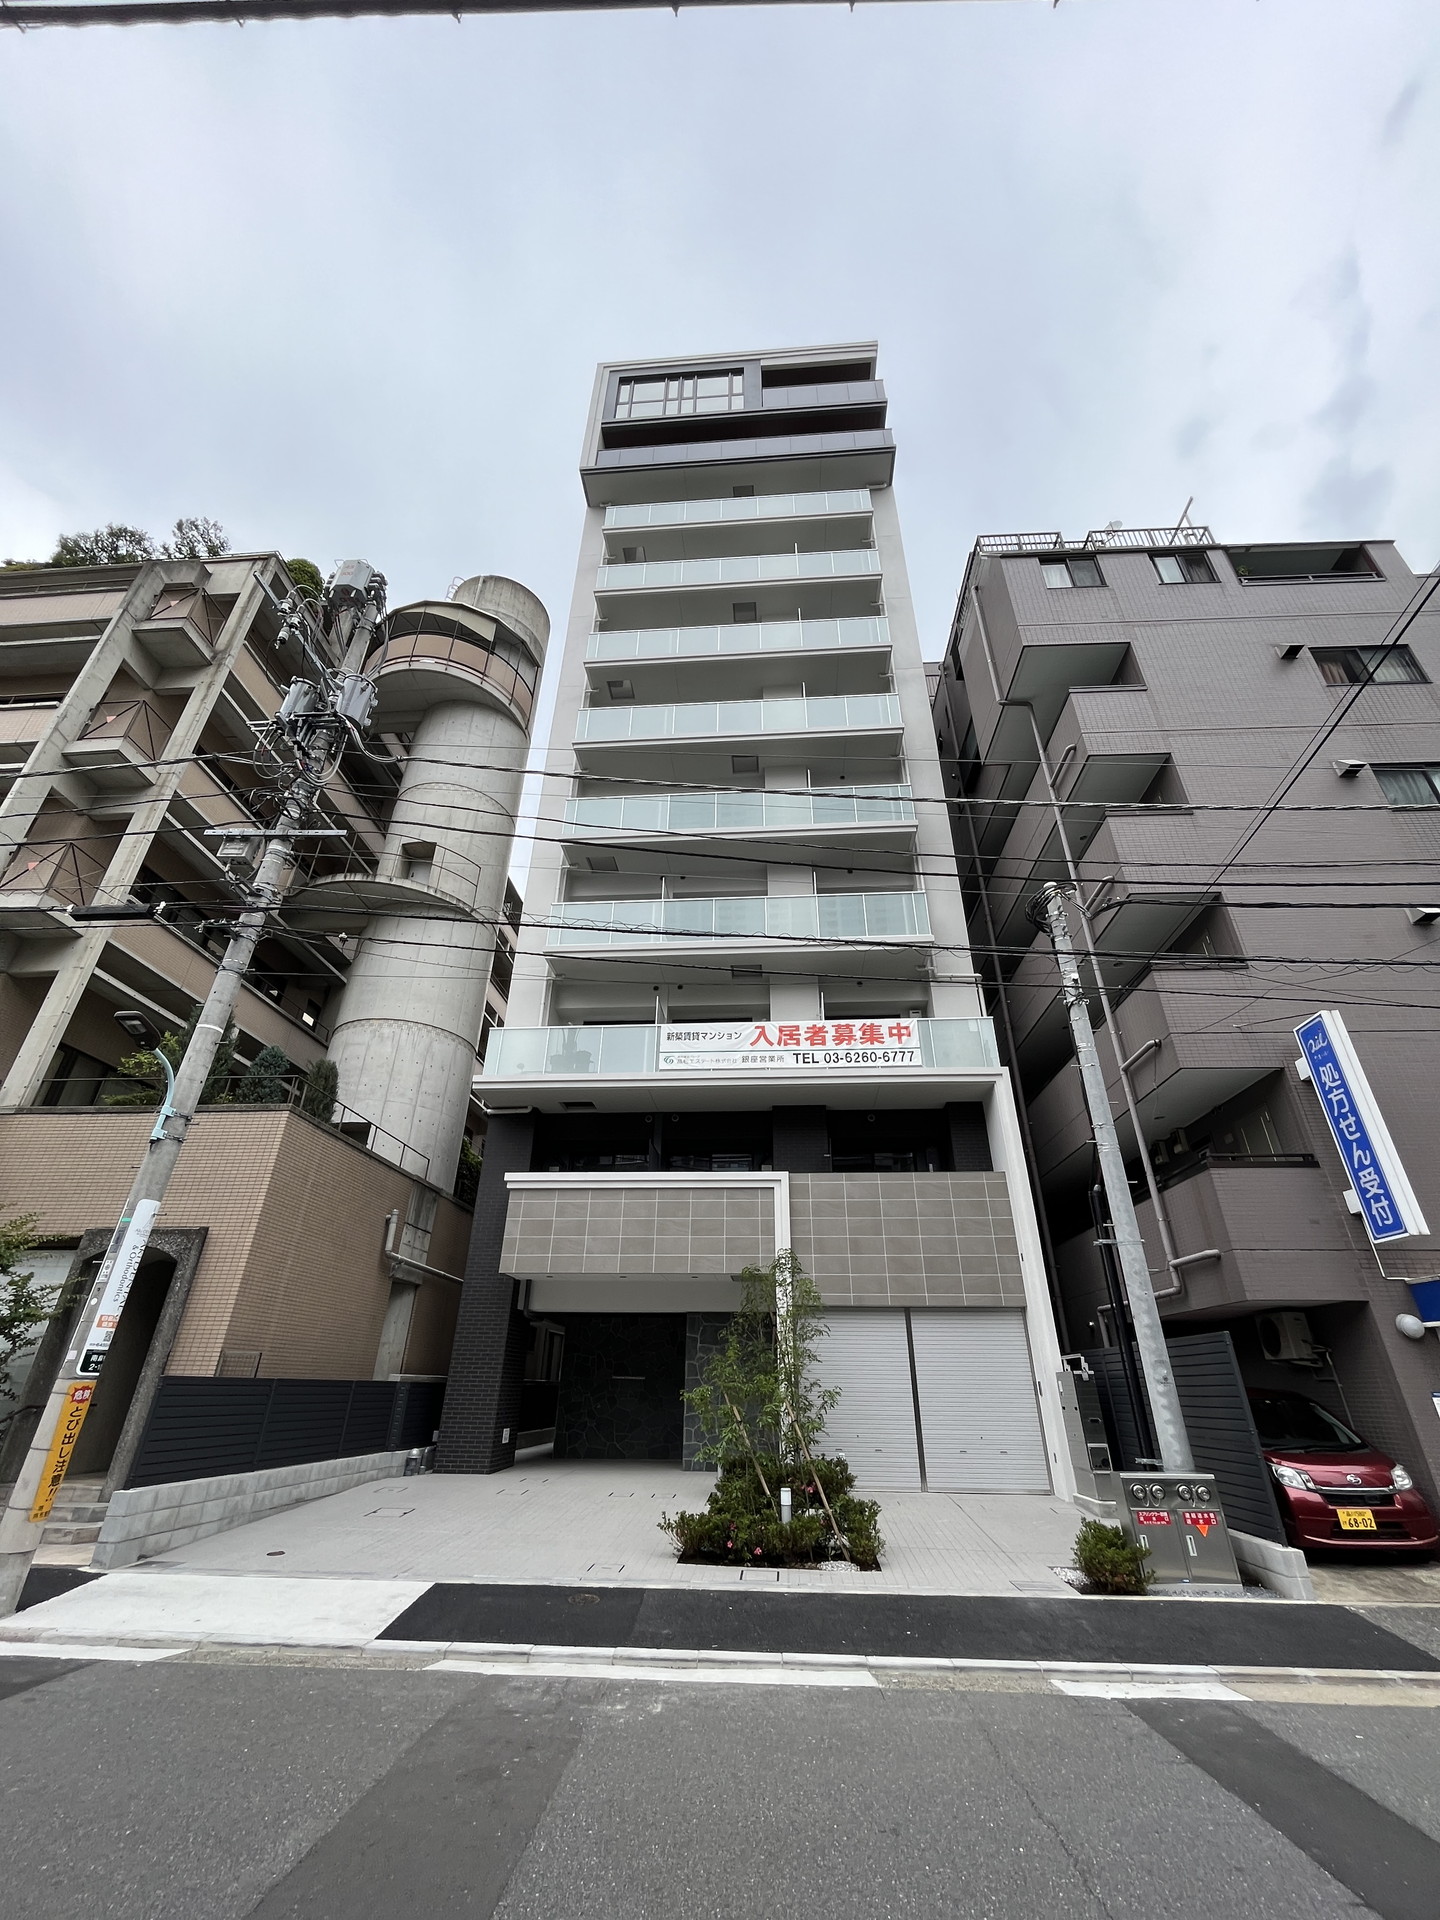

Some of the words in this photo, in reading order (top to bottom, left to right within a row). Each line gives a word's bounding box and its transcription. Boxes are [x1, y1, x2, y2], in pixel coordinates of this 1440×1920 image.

[666, 1031, 743, 1042] 新築賃貸マンション
[749, 1021, 913, 1048] 入居者募集中
[741, 1054, 785, 1064] 銀座営業所
[792, 1052, 820, 1064] TEL
[823, 1050, 915, 1064] 03-6260-6777
[1318, 1062, 1393, 1227] 処方せん受付
